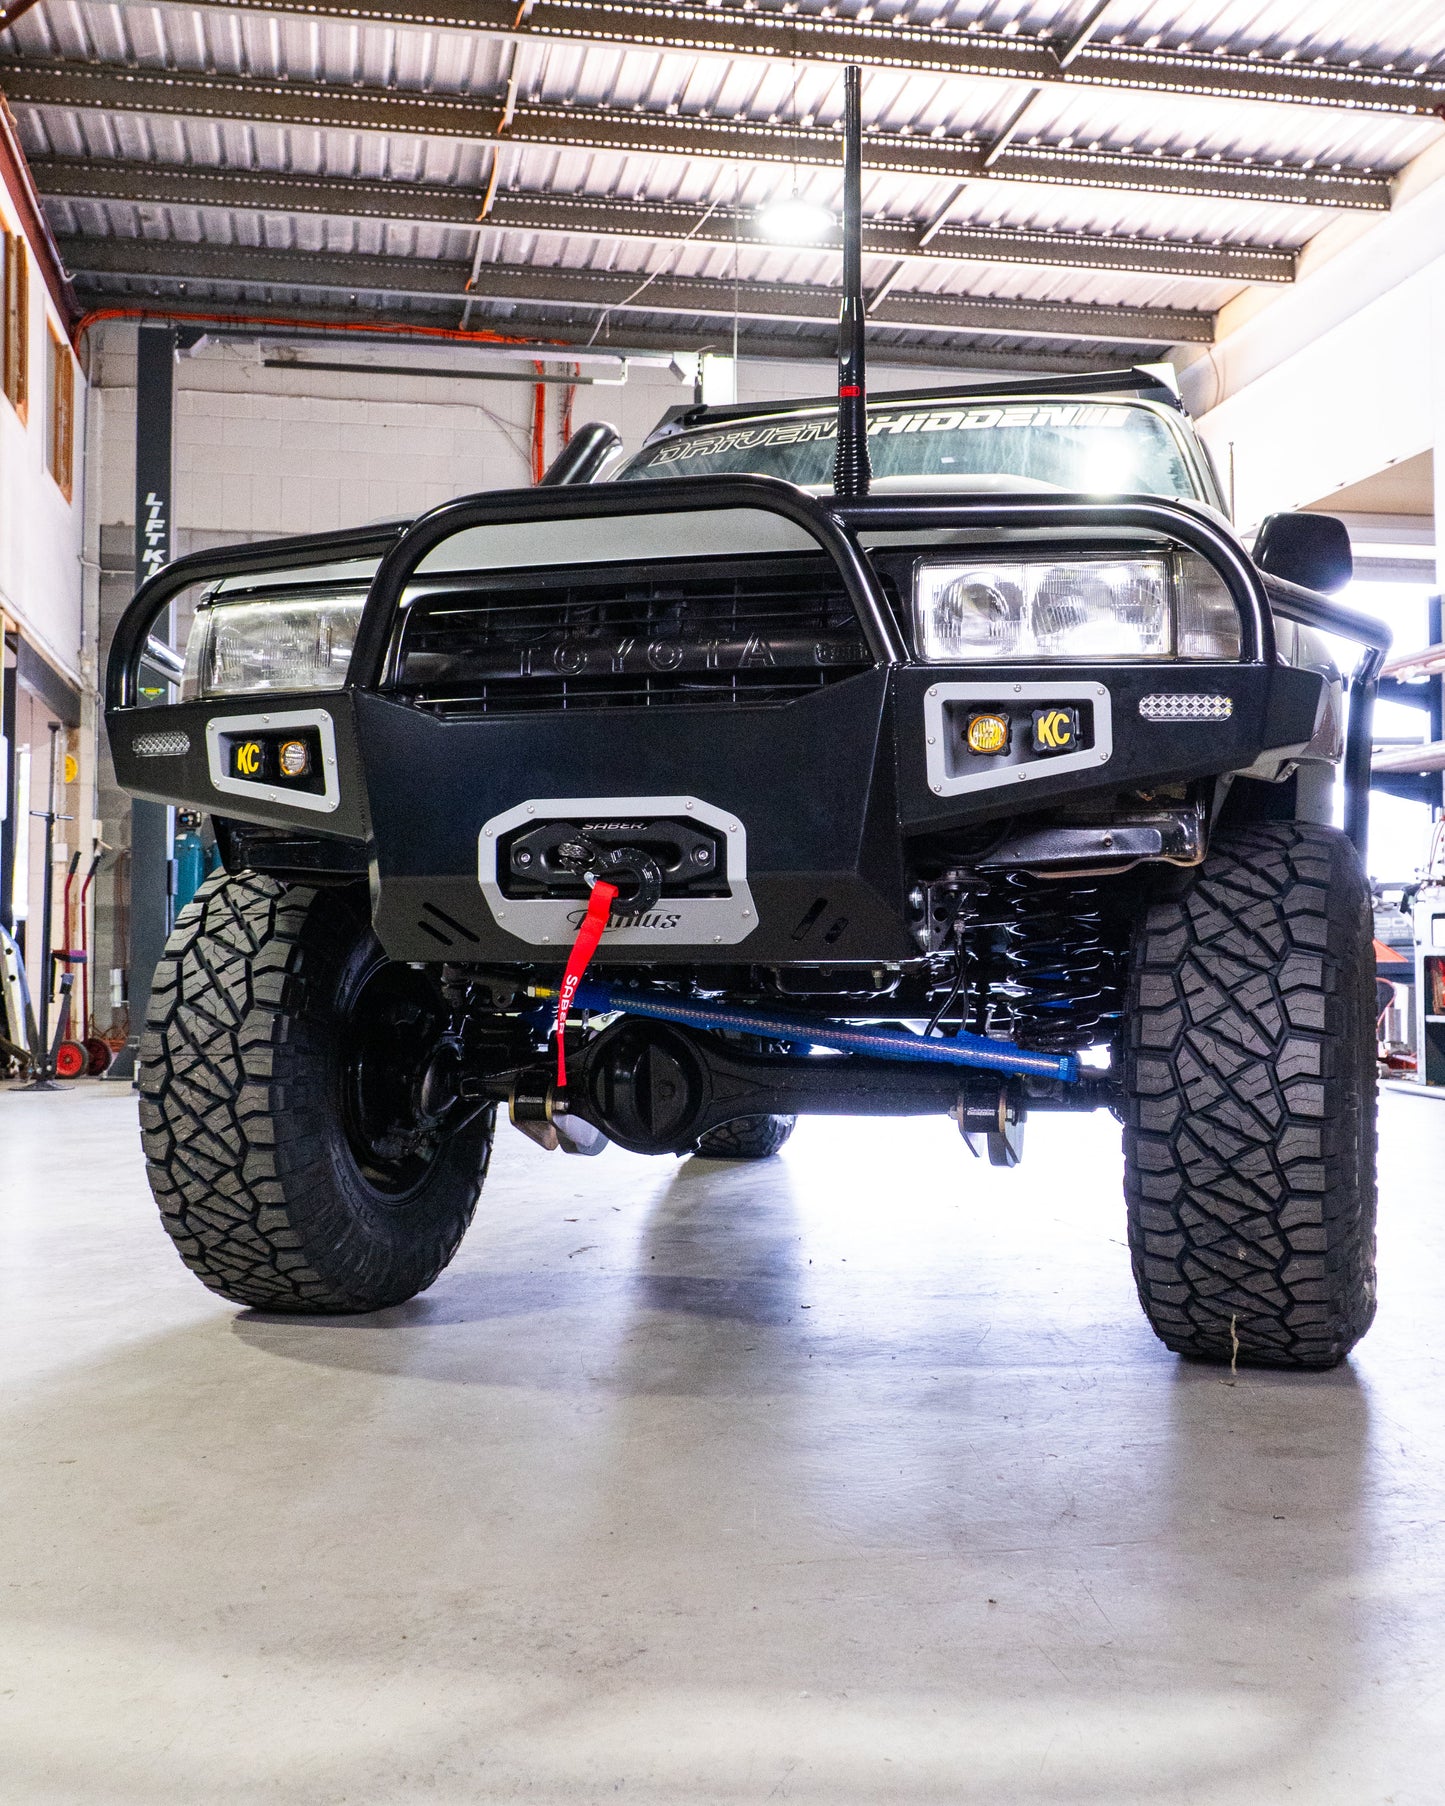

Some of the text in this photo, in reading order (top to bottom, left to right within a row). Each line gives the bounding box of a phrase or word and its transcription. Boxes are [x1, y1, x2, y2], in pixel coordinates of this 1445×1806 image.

[512, 631, 776, 676] TOYOTA
[1037, 711, 1071, 747] KC
[237, 742, 260, 774] KC
[582, 822, 646, 831] SABER
[559, 975, 578, 1034] SABER
